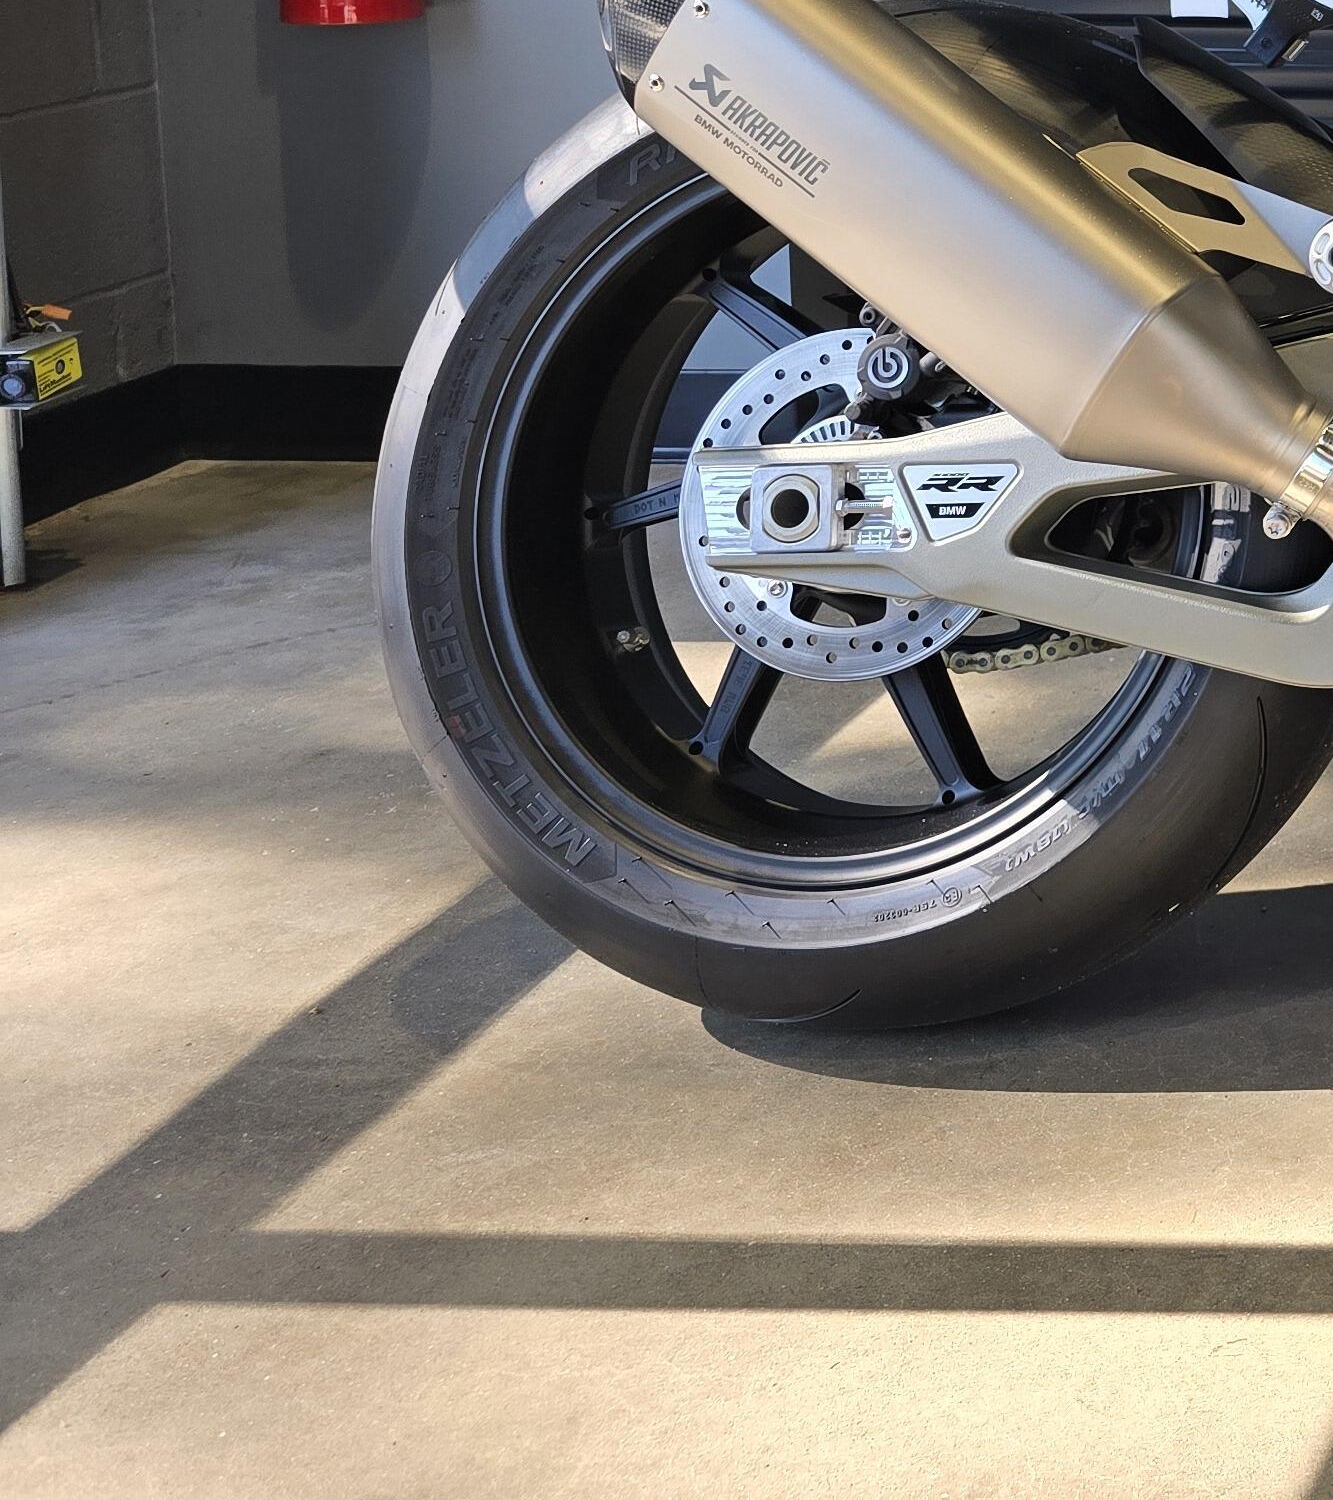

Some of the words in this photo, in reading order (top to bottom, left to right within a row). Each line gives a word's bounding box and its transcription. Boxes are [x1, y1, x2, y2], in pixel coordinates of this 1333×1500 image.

[694, 113, 723, 140] BMW
[722, 136, 784, 188] MOTORRAD
[916, 475, 1006, 493] RR
[938, 505, 967, 516] BMW
[422, 601, 598, 867] METZELER
